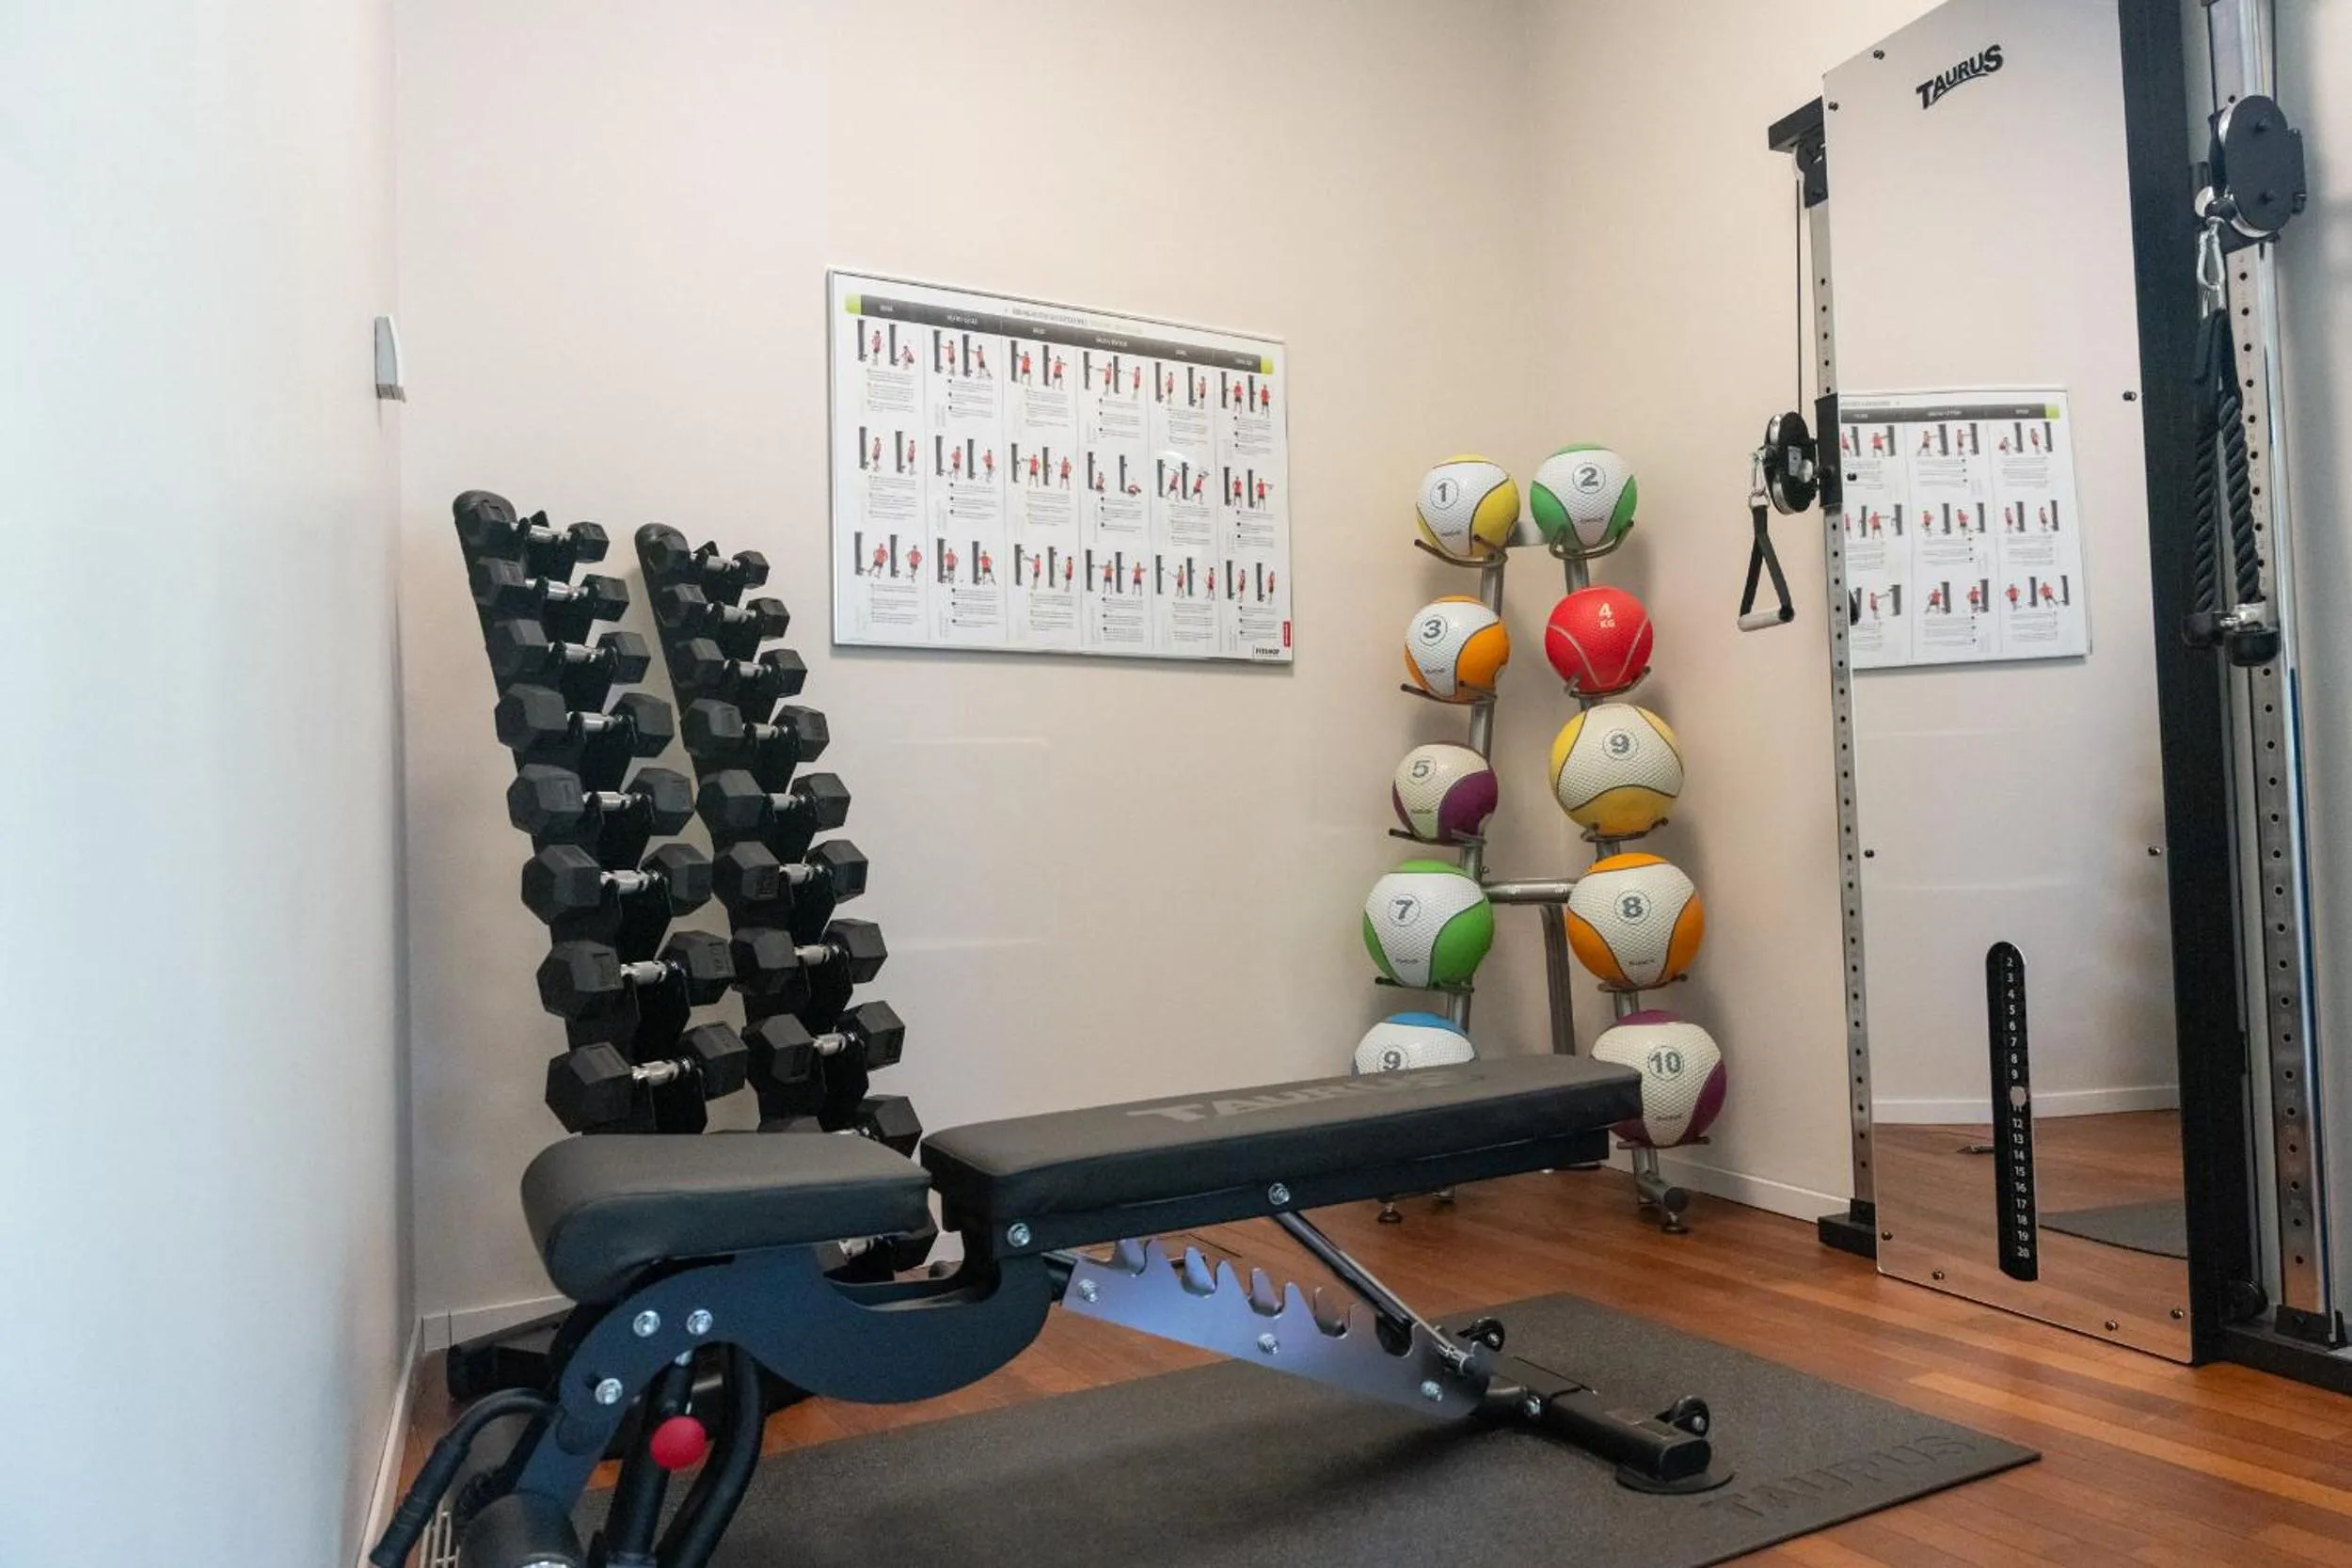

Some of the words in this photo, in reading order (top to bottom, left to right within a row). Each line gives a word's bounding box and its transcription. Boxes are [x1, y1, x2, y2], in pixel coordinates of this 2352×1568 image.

[1915, 43, 2004, 110] TAURUS
[1581, 467, 1599, 487] 2
[1437, 483, 1447, 502] 1
[1598, 602, 1613, 618] 4
[1422, 620, 1441, 639] 3
[1599, 619, 1615, 628] KG
[1611, 733, 1630, 753] 9
[1411, 759, 1431, 779] 5
[1394, 898, 1413, 920] 7
[1621, 895, 1644, 919] 8
[2006, 957, 2013, 967] 2
[2007, 973, 2014, 983] 3
[2008, 989, 2015, 999] 4
[2009, 1005, 2016, 1016] 5
[2009, 1021, 2016, 1032] 6
[2010, 1037, 2017, 1047] 7
[1383, 1050, 1401, 1070] 9
[1649, 1051, 1682, 1073] 10
[2010, 1053, 2019, 1064] 8
[2011, 1069, 2019, 1080] 9
[2012, 1117, 2023, 1129] 12
[2013, 1133, 2024, 1145] 13
[2014, 1149, 2025, 1161] 14
[2014, 1165, 2026, 1177] 15
[2015, 1181, 2026, 1193] 16
[2016, 1198, 2026, 1210] 17
[2017, 1214, 2028, 1226] 18
[2017, 1230, 2029, 1242] 19
[2017, 1246, 2030, 1259] 20
